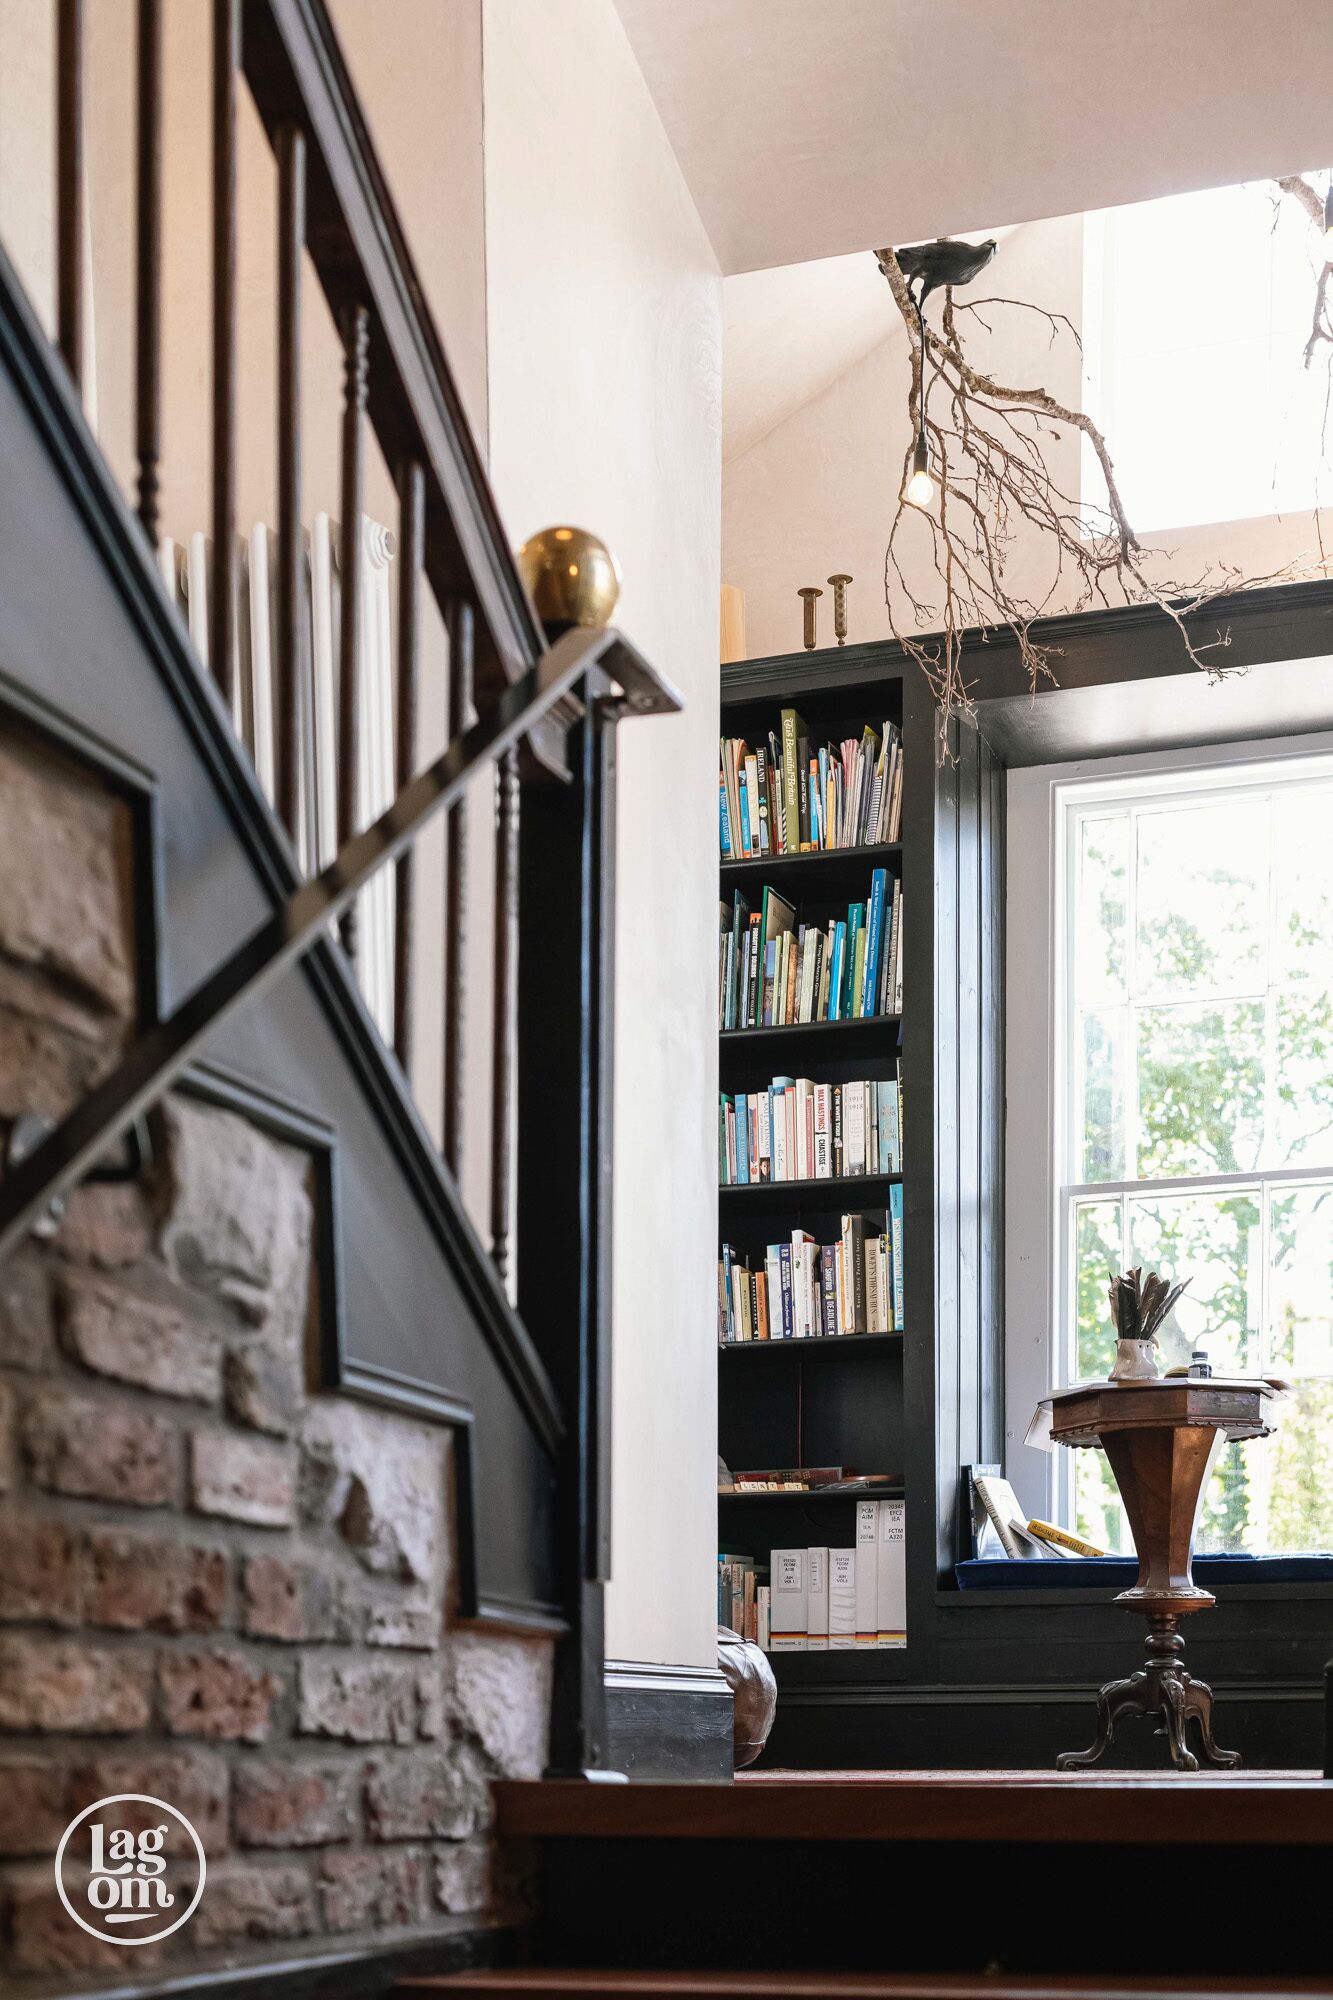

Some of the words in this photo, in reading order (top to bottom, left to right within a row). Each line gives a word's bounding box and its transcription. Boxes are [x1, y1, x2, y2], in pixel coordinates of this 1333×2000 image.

[757, 749, 765, 783] IRELAND
[785, 738, 795, 774] Beautiful
[722, 811, 730, 844] Zealand
[893, 1217, 902, 1279] IMPRESSIONISM
[827, 1301, 835, 1329] DEADLINE
